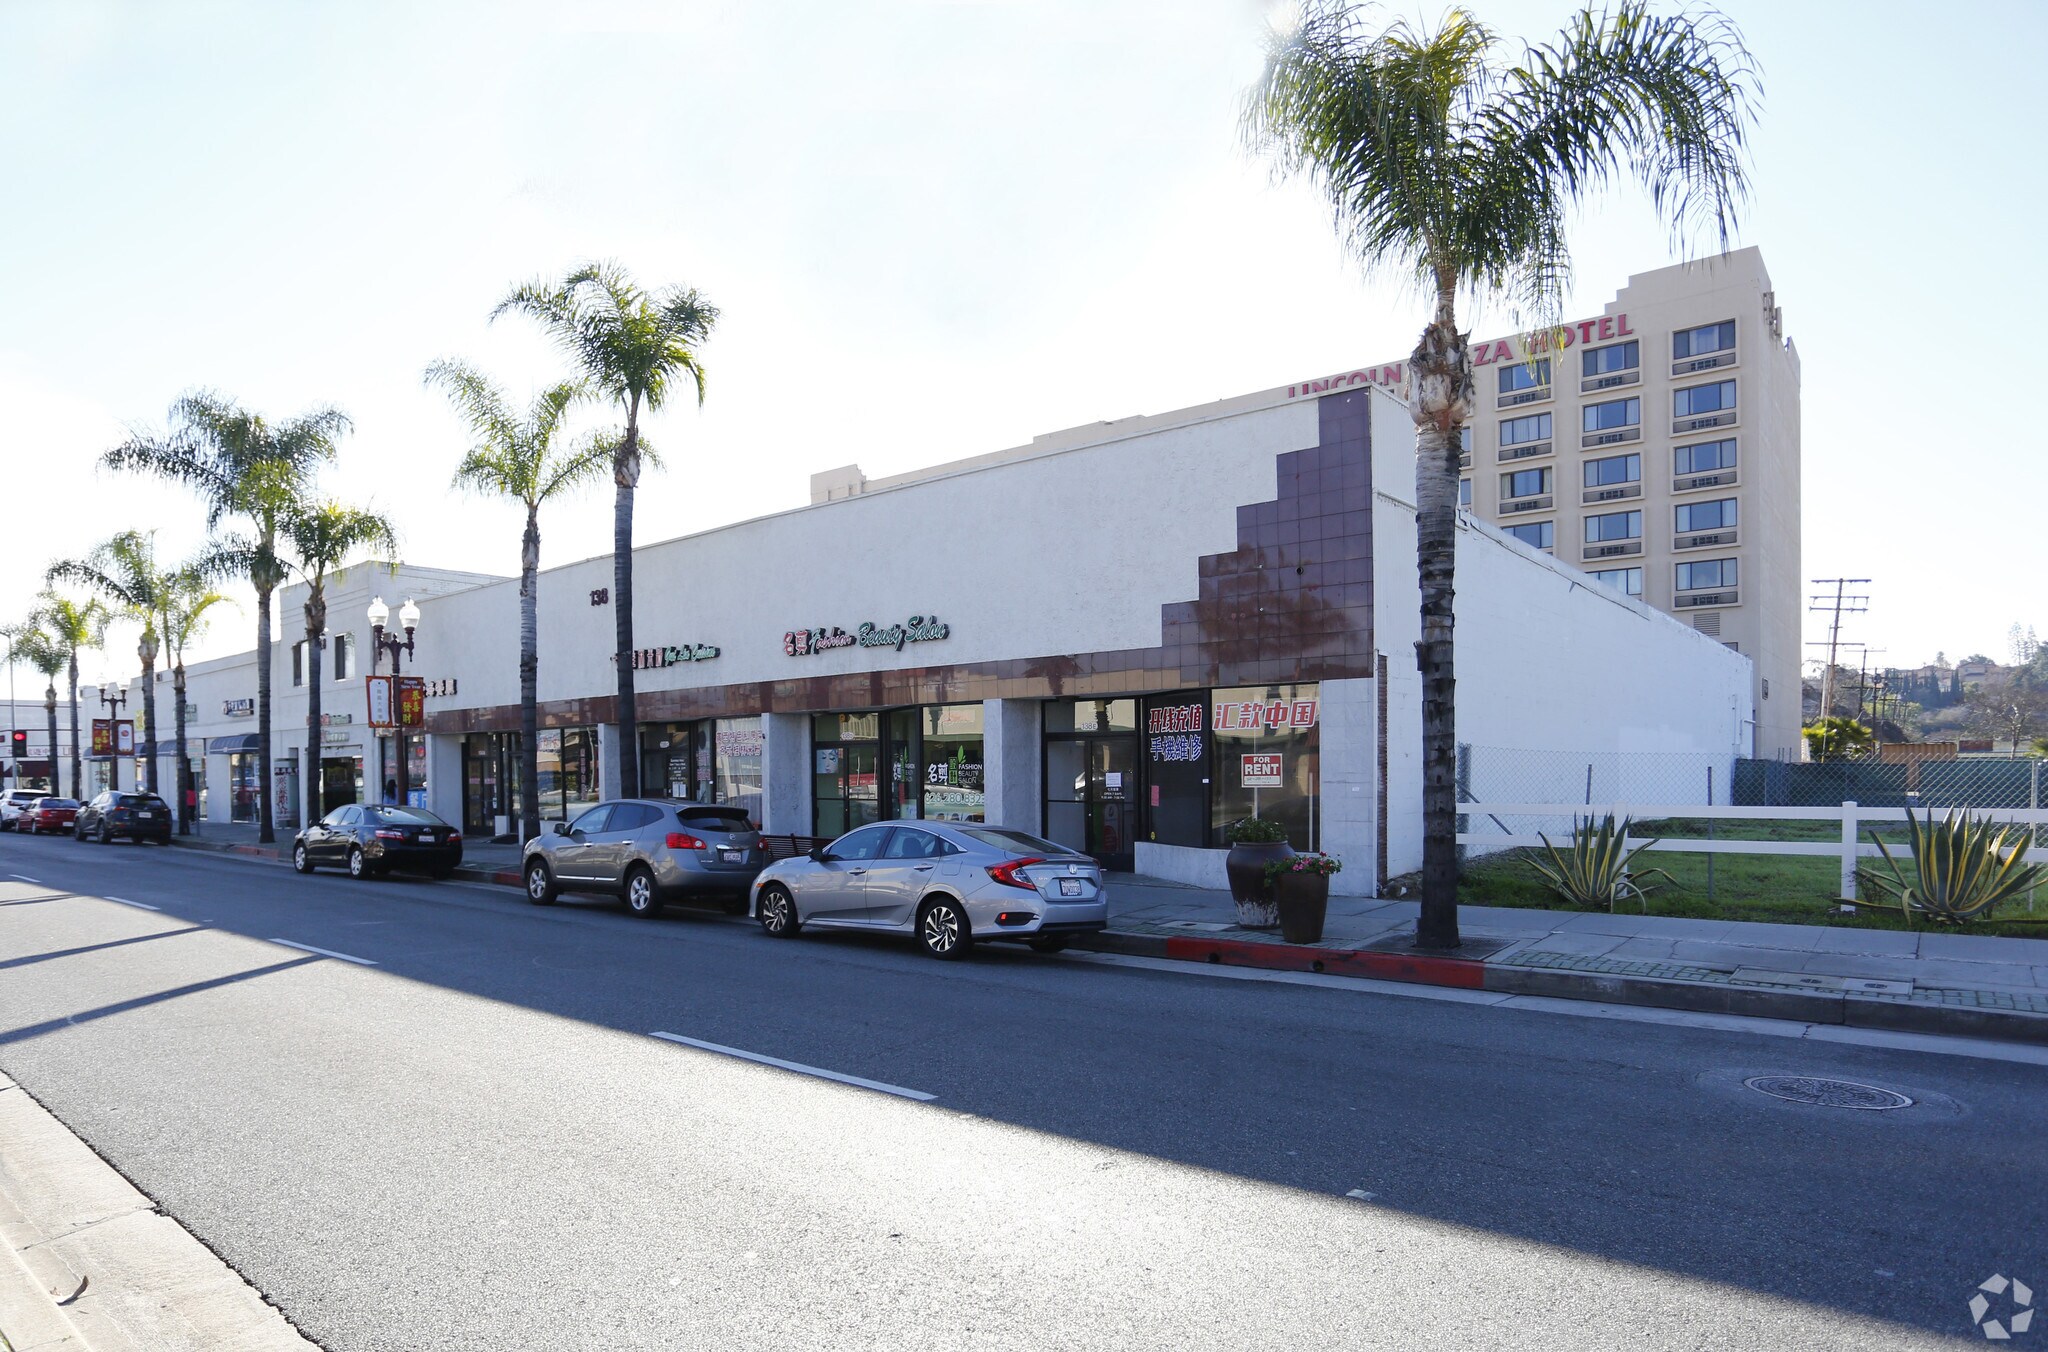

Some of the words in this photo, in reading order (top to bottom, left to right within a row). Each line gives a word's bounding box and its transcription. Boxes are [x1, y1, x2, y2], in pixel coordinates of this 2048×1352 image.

[1528, 313, 1634, 355] HOTEL
[589, 588, 609, 606] 138
[858, 621, 907, 651] Beauty
[905, 615, 950, 643] Salon
[1211, 699, 1319, 731] 汇款中国
[1150, 734, 1203, 762] 手機維修
[958, 776, 977, 784] SALON
[1244, 763, 1280, 775] RENT
